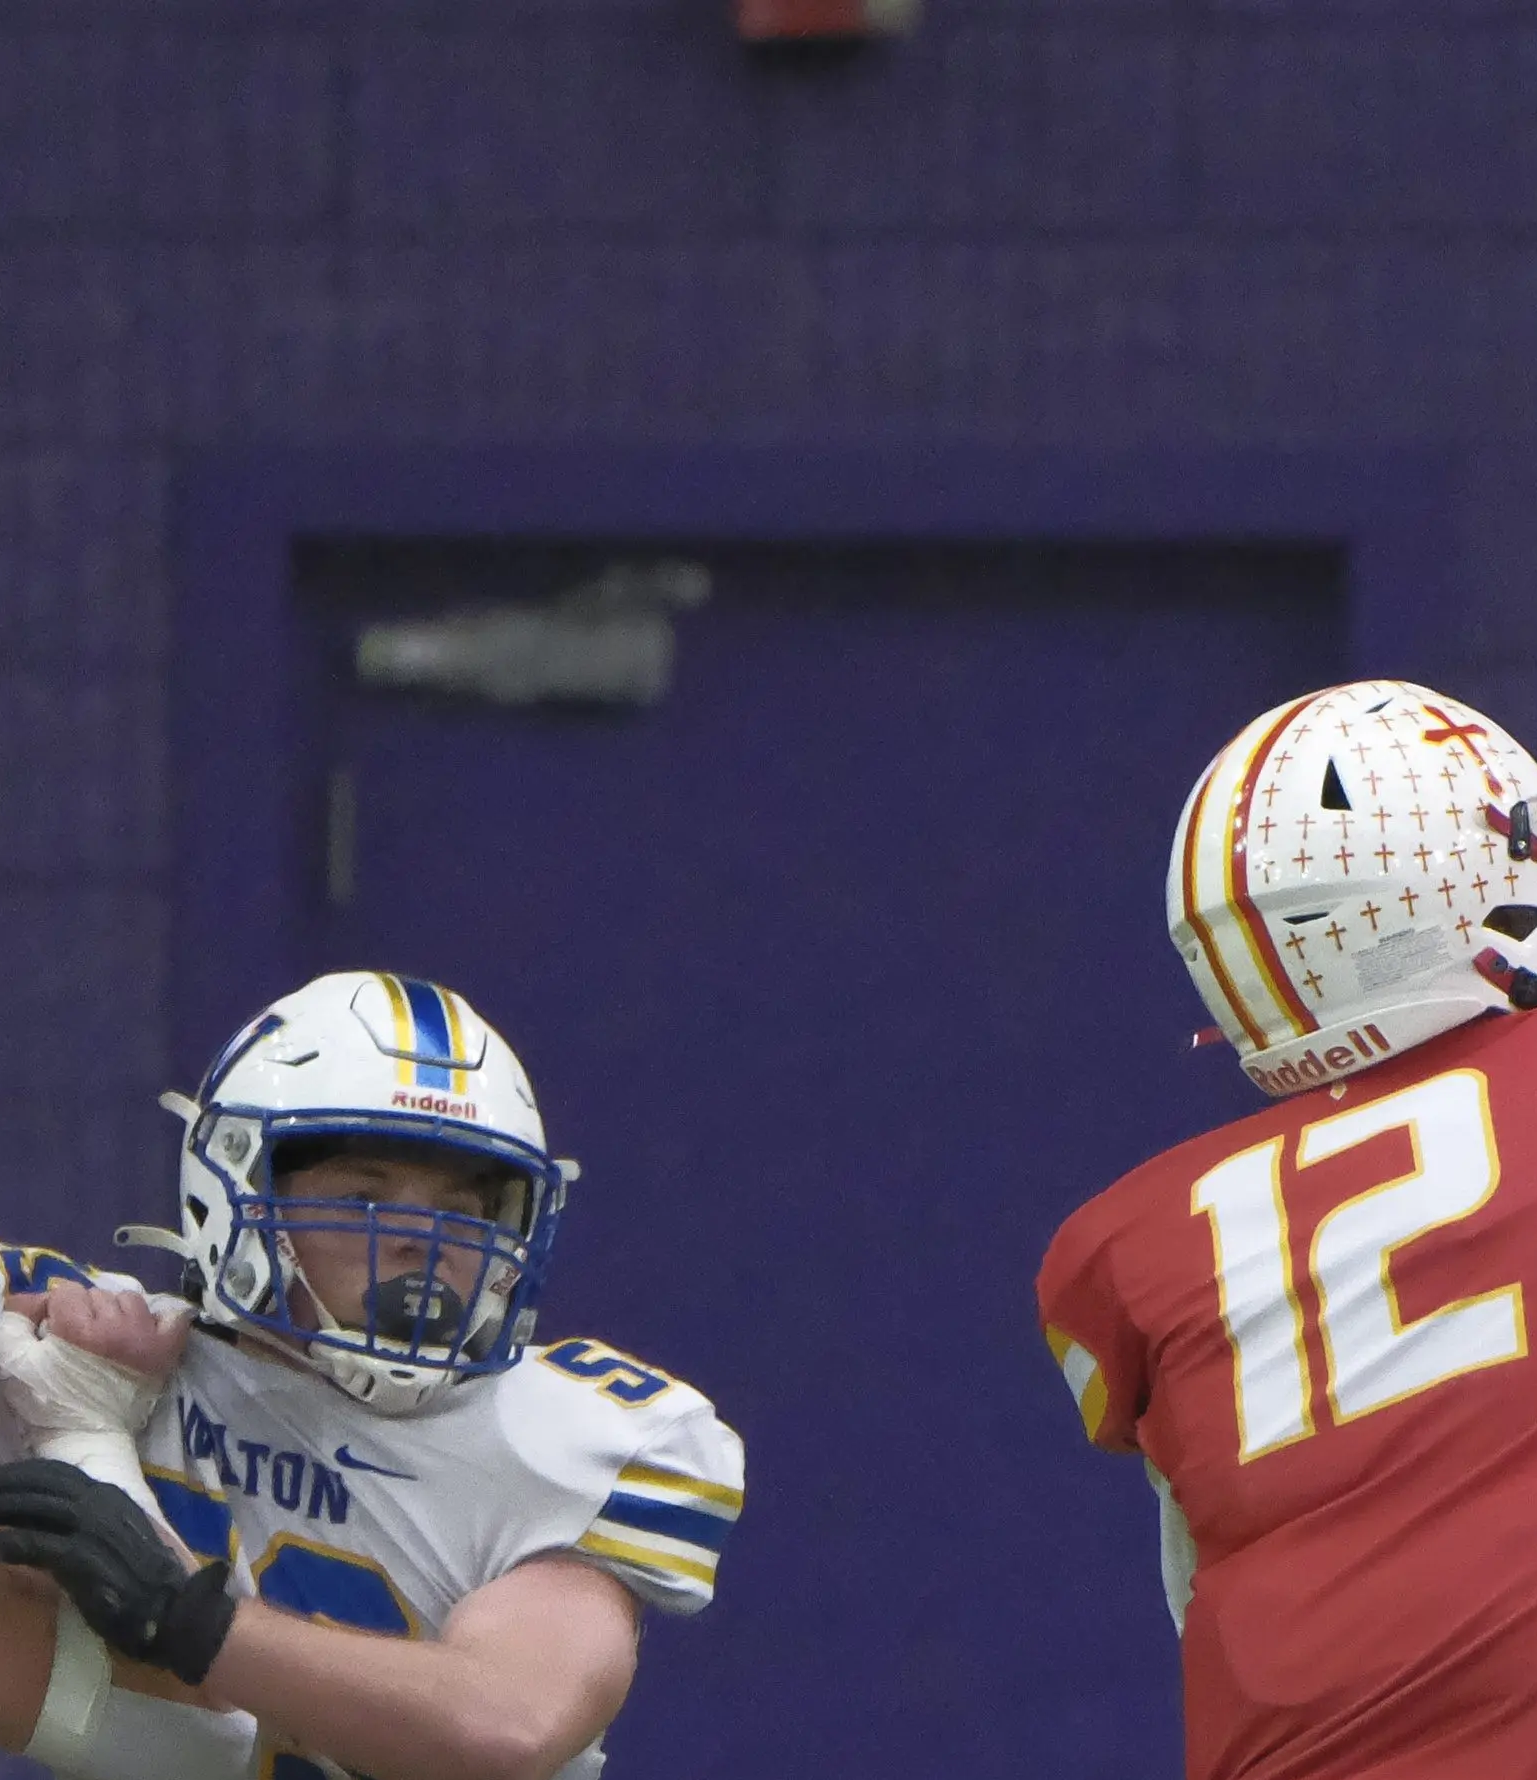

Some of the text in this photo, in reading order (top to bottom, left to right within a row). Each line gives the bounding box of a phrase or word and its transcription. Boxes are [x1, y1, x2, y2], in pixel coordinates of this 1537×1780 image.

[1246, 1022, 1392, 1092] Riddell
[391, 1090, 477, 1119] Riddell
[1190, 1066, 1529, 1466] 12
